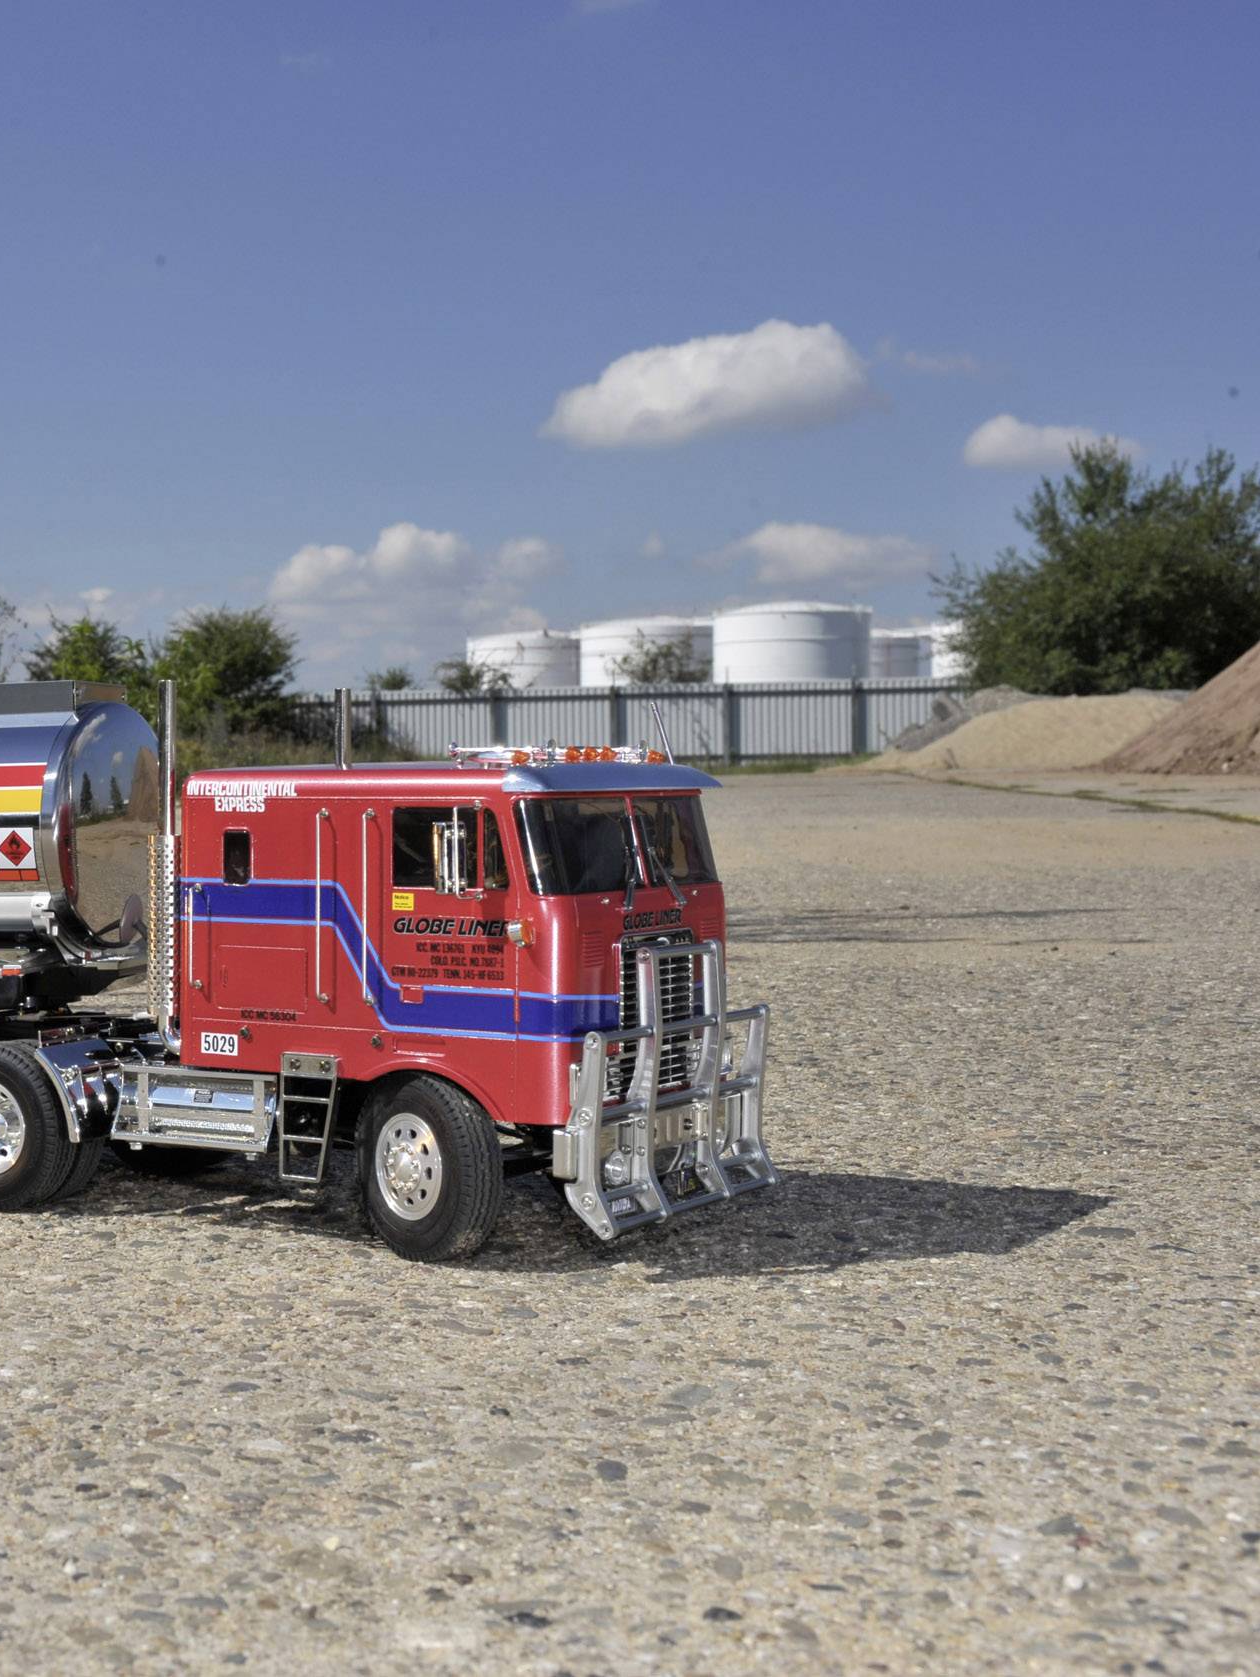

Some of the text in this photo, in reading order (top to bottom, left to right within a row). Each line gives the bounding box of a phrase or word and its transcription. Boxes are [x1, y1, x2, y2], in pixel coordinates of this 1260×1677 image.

[186, 780, 298, 797] INTERCONTINENTAL
[214, 796, 266, 813] EXPRESS
[393, 917, 456, 935] GLOBE
[623, 908, 682, 931] GLOBE LINER
[204, 1034, 236, 1054] 5029
